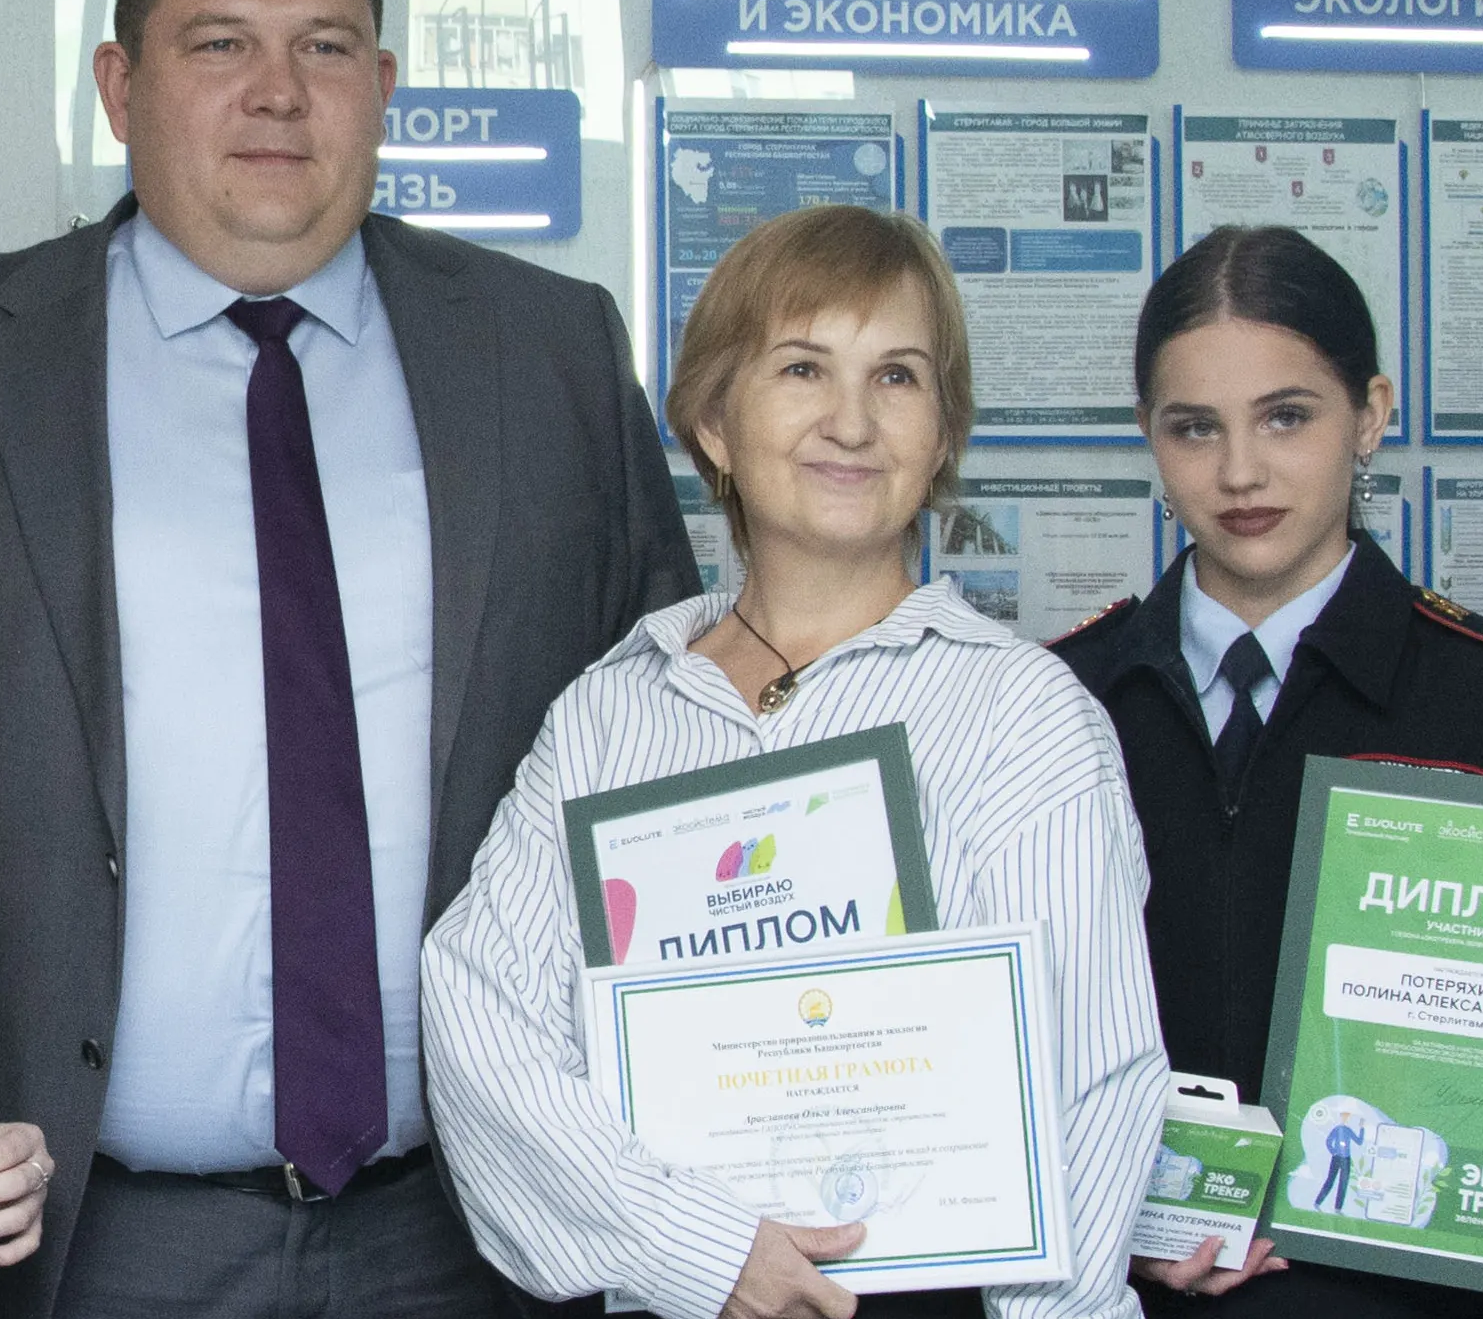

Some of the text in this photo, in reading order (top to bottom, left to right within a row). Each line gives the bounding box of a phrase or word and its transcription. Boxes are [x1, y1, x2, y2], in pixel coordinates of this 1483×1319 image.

[784, 0, 1077, 37] ЭКОНОМИКА
[1364, 817, 1423, 833] EVOLUTE
[706, 878, 793, 908] ВЫБИРАЮ
[708, 893, 795, 917] ЧИСТЫЙ ВОЗДУХ
[1342, 982, 1413, 1004] ПОЛИНА
[717, 1056, 933, 1090] ПОЧЕТНАЯ ГРАМОТА
[1204, 1183, 1249, 1198] ТРЕКЕР
[1167, 1214, 1242, 1232] ПОТЕРЯХИНА
